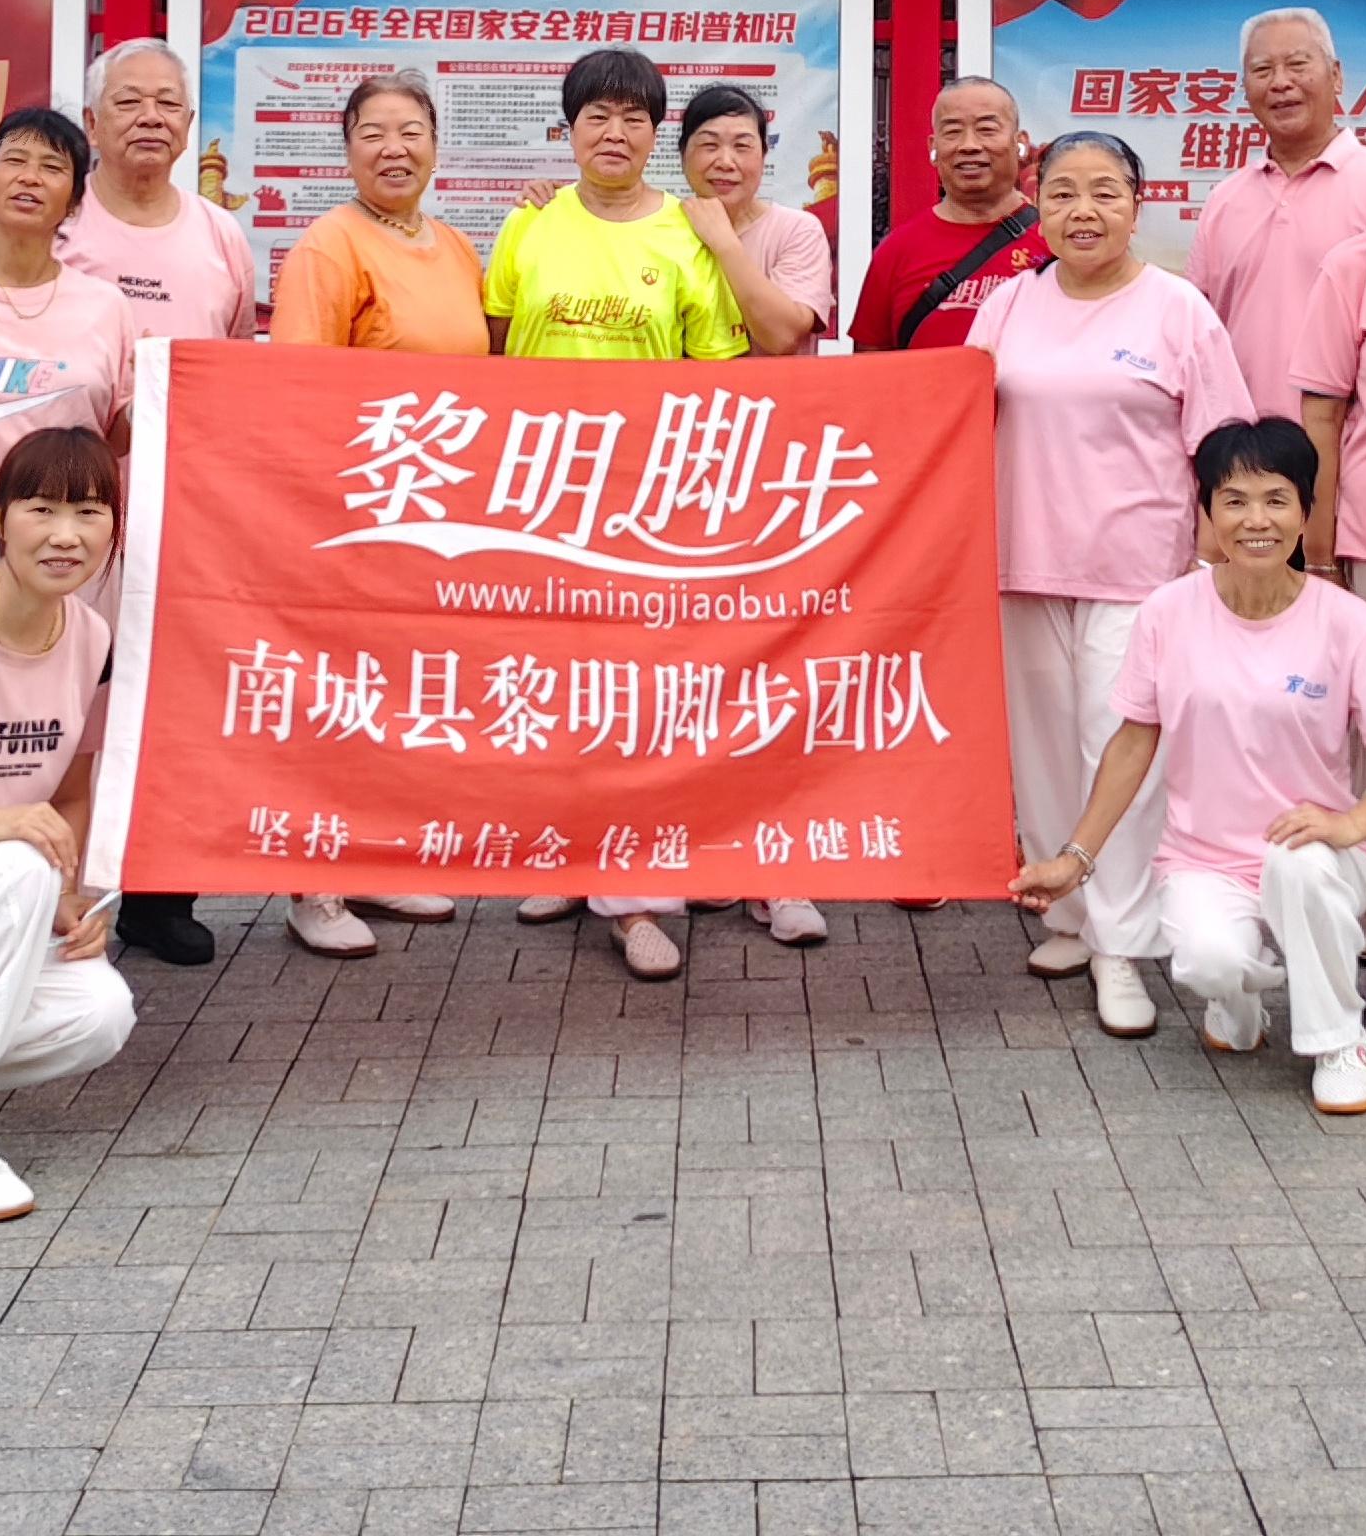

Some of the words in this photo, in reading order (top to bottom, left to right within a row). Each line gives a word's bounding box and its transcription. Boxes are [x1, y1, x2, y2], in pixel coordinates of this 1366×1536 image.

[245, 7, 797, 44] 2026年全民国家安全教育日科普知识
[544, 292, 652, 327] 黎明脚步
[343, 388, 880, 548] 黎明脚步
[436, 575, 852, 631] www.limingjiaobu.net
[219, 639, 952, 758] 南城县黎明脚步团队
[243, 807, 570, 870] 坚持一种信念
[595, 815, 904, 871] 传递一份健康
